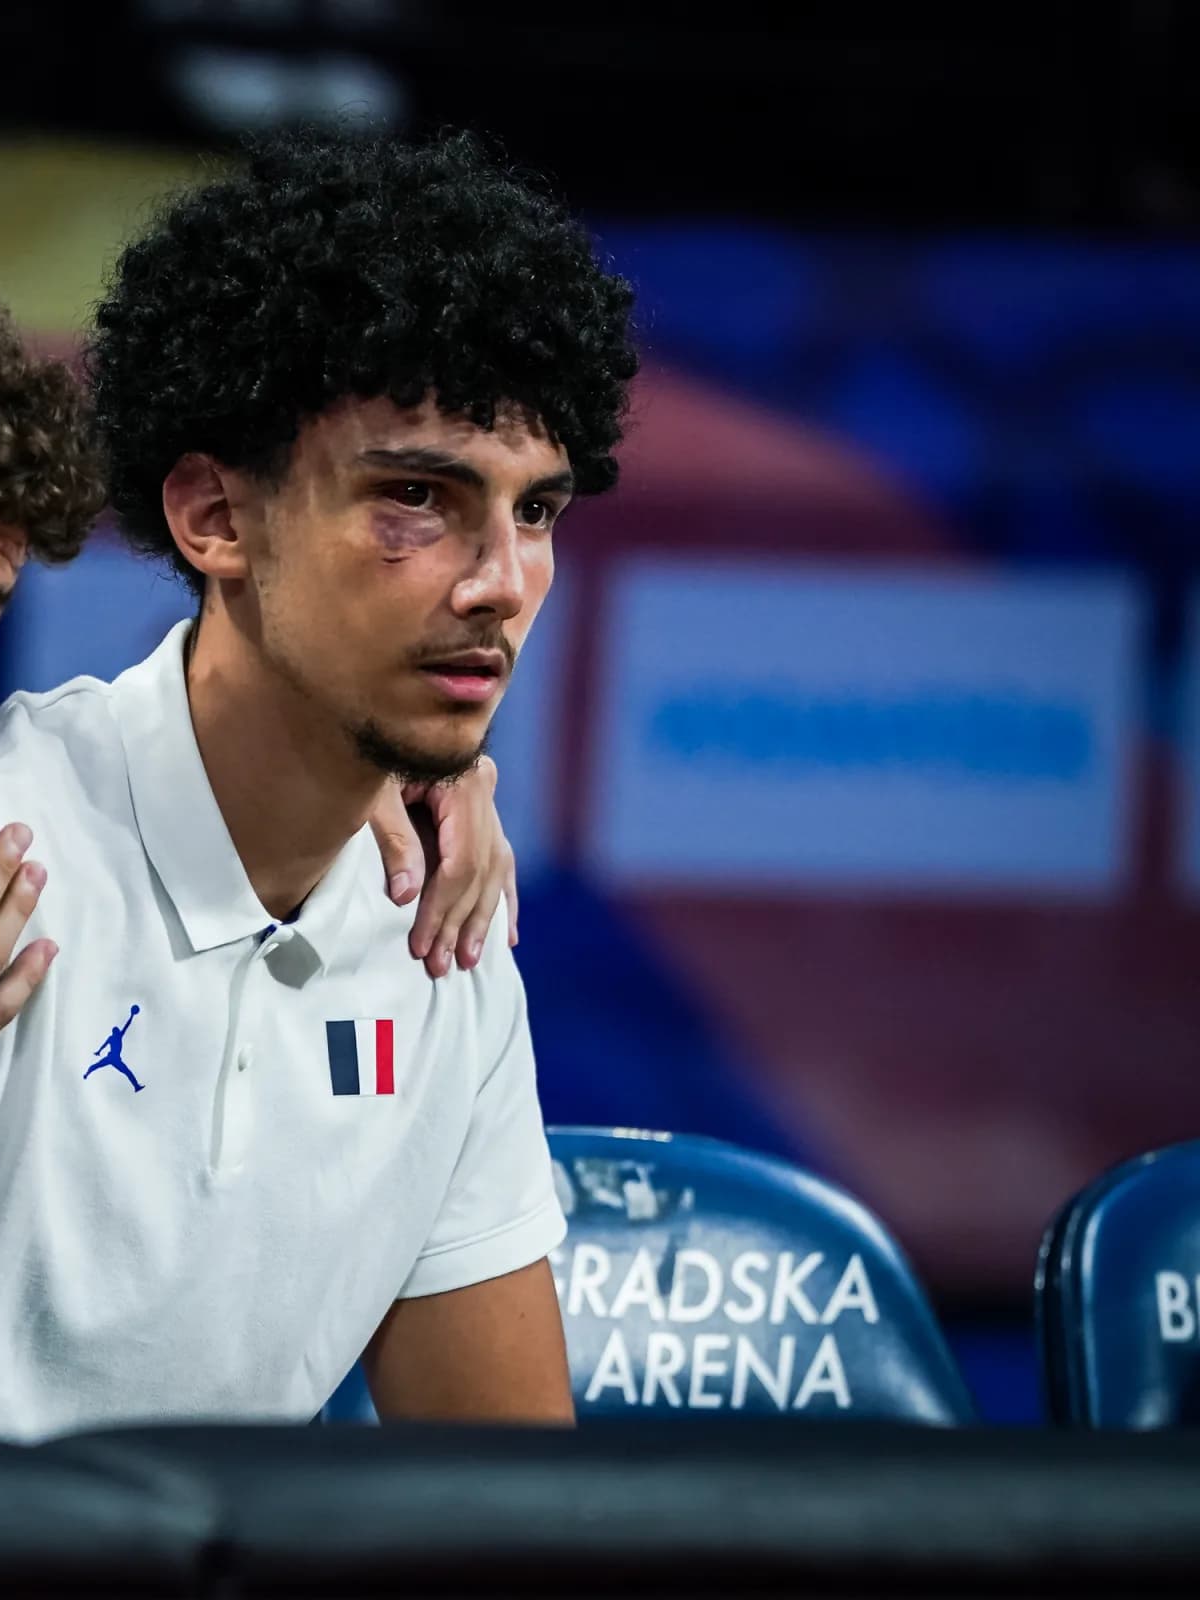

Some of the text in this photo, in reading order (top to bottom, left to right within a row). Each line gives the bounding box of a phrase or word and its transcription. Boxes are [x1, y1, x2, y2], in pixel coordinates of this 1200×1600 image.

[550, 1244, 880, 1325] RADSKA
[1155, 1270, 1200, 1342] B
[585, 1332, 852, 1410] ARENA
